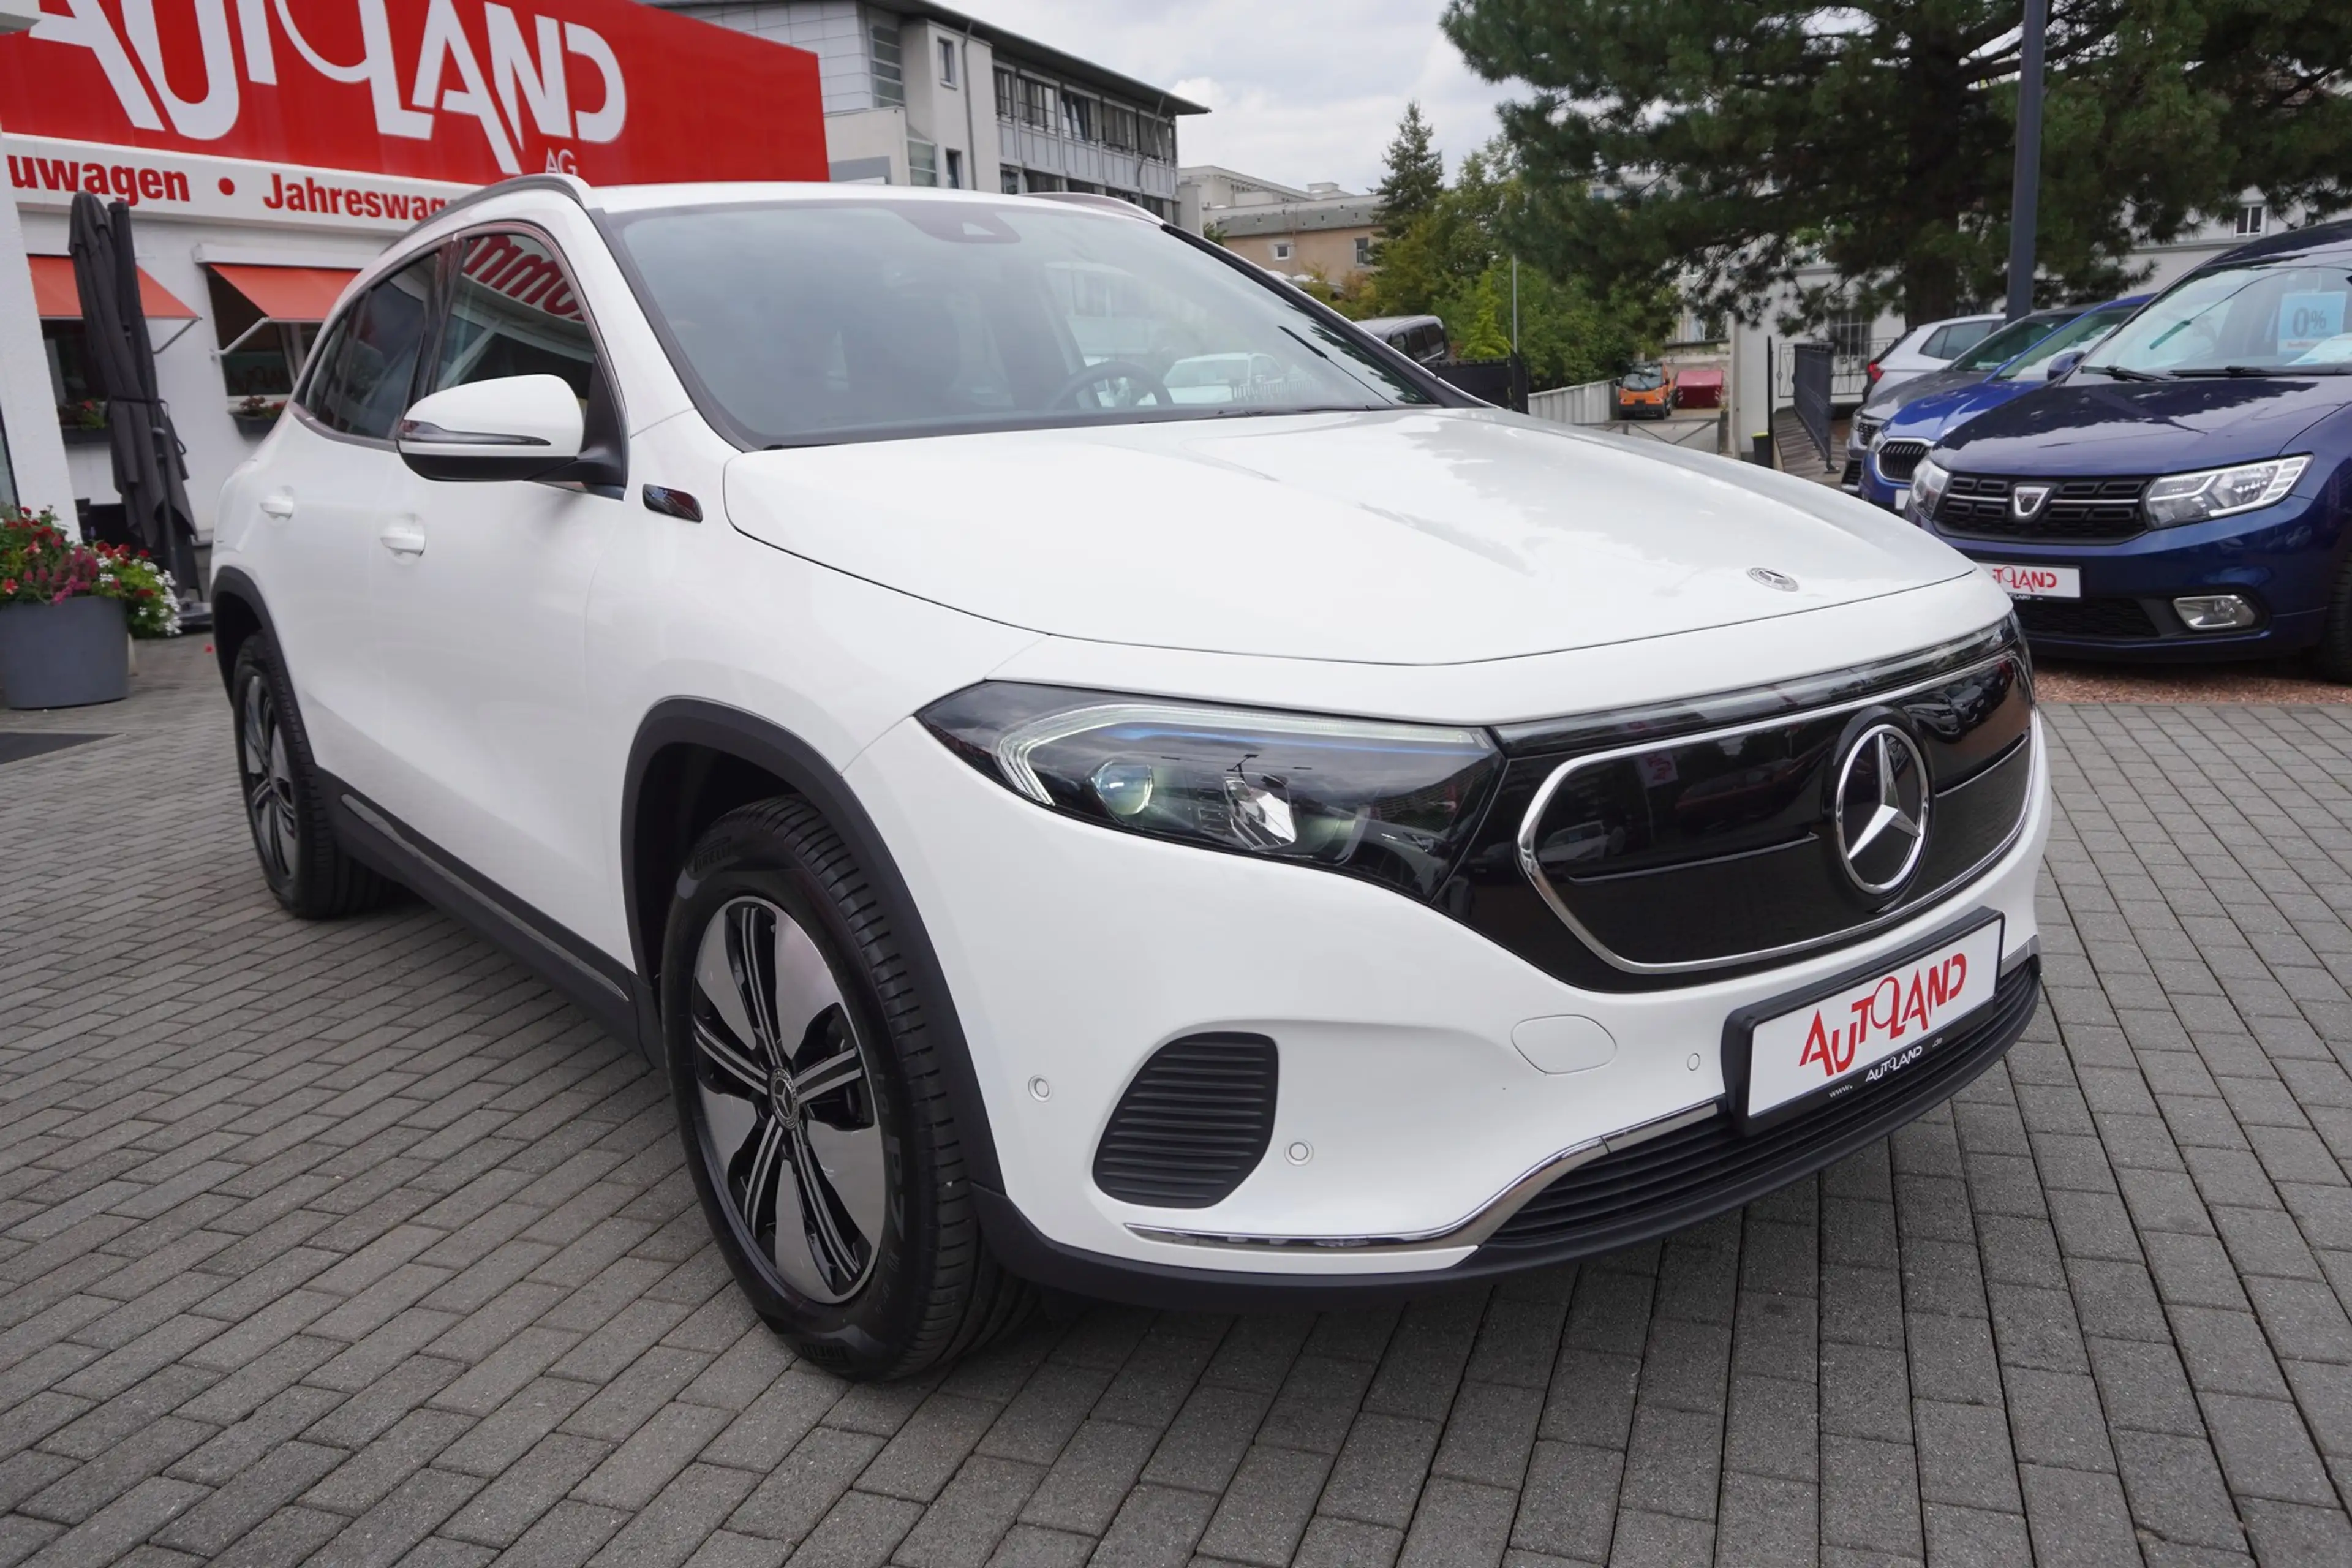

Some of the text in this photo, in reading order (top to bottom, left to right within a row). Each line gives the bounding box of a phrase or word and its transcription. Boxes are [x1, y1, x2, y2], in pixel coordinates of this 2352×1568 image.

[545, 147, 578, 175] AG
[2293, 307, 2326, 337] 0%
[1799, 953, 1967, 1076] AUTOLAND
[1865, 1045, 1923, 1083] AUTOLAND
